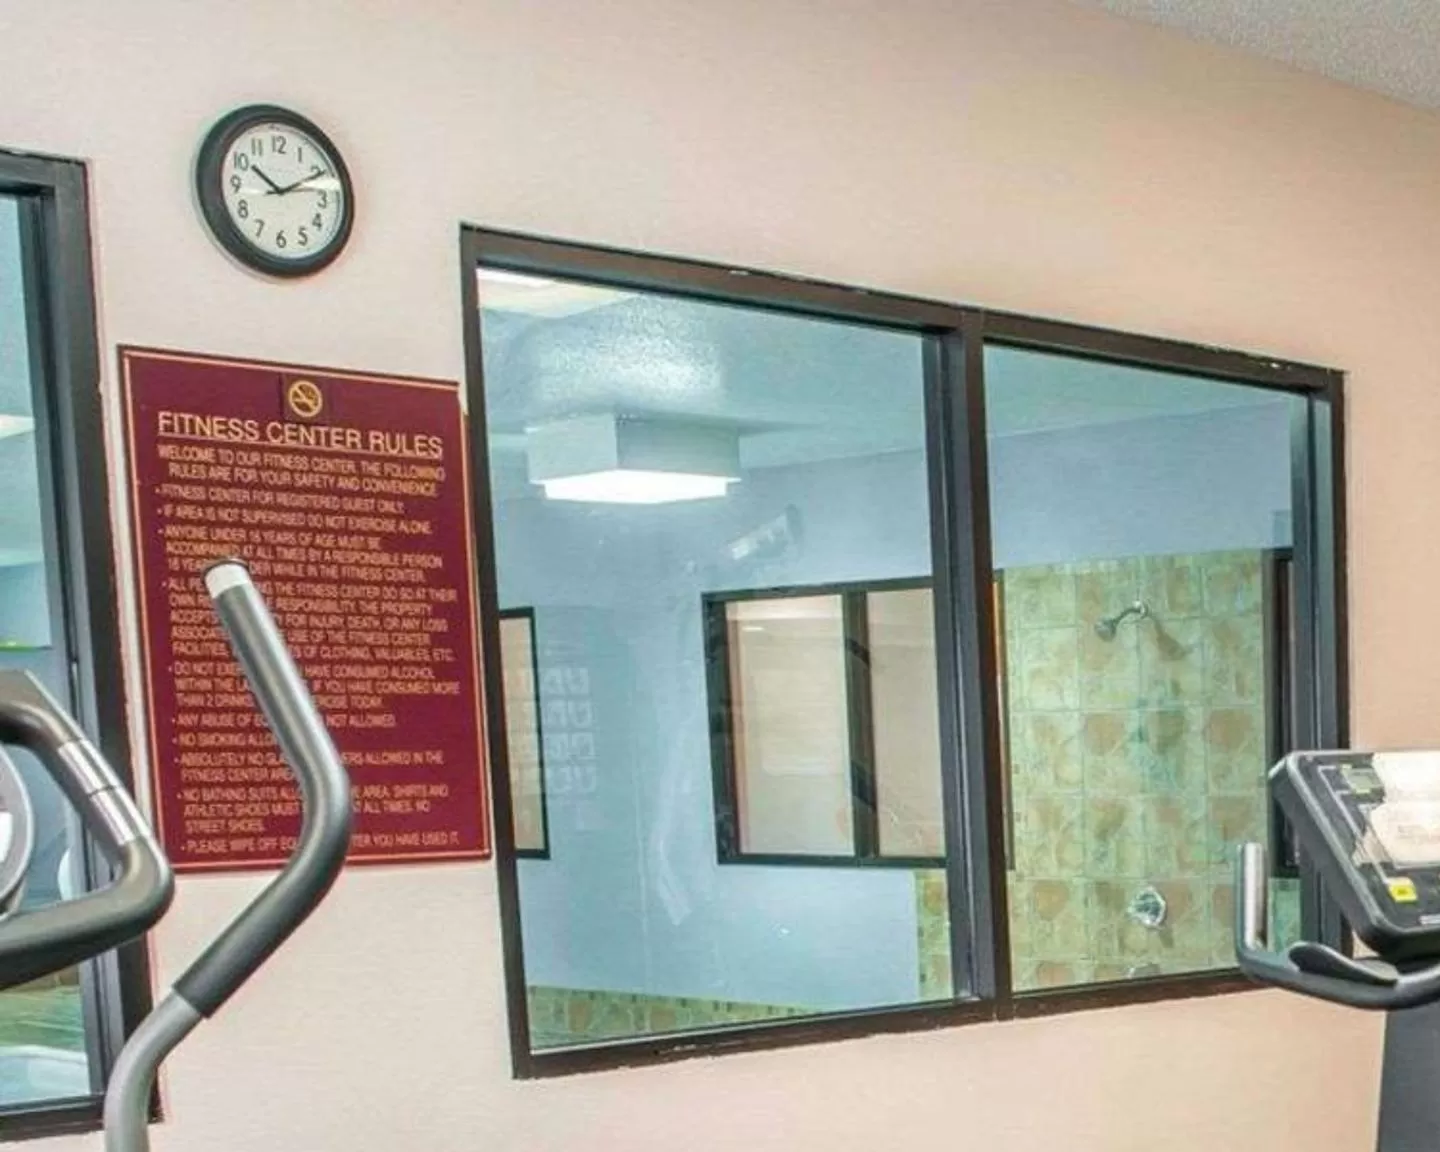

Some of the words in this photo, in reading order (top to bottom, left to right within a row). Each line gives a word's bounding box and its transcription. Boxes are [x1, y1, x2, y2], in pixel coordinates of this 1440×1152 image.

[251, 138, 264, 157] 11
[271, 135, 287, 154] 12
[233, 151, 249, 172] 10
[297, 147, 303, 163] 1
[230, 175, 242, 193] 9
[237, 199, 249, 219] 8
[317, 190, 328, 209] 3
[254, 219, 265, 238] 7
[312, 213, 323, 231] 4
[276, 229, 287, 248] 6
[298, 227, 309, 246] 5
[158, 411, 260, 441] FITNESS
[265, 421, 362, 450] CENTER
[369, 430, 443, 460] RULES
[157, 444, 217, 463] WELCOME
[218, 448, 235, 465] TO
[236, 451, 261, 467] OUR
[263, 453, 309, 472] FITNESS
[361, 460, 381, 477] THE
[383, 462, 446, 482] FOLLOWING
[168, 462, 207, 480] RULES
[208, 465, 232, 482] ARE
[234, 467, 258, 483] FOR
[260, 470, 292, 486] YOUR
[294, 472, 335, 489] SAFETY
[337, 476, 361, 491] AND
[161, 483, 206, 500] FITNESS
[208, 486, 250, 503] CENTER
[252, 489, 275, 505] FOR
[217, 507, 241, 522] NOT
[164, 524, 209, 541] ANYONE
[210, 527, 247, 543] UNDER
[298, 531, 313, 547] OF
[401, 552, 443, 570] PERSON
[341, 565, 383, 582] FITNESS
[297, 582, 338, 599] FITNESS
[339, 584, 381, 600] CENTER
[381, 601, 434, 617] PROPERTY
[180, 752, 245, 767] ABSOLUTELY
[181, 767, 226, 783] FITNESS
[227, 767, 269, 783] CENTER
